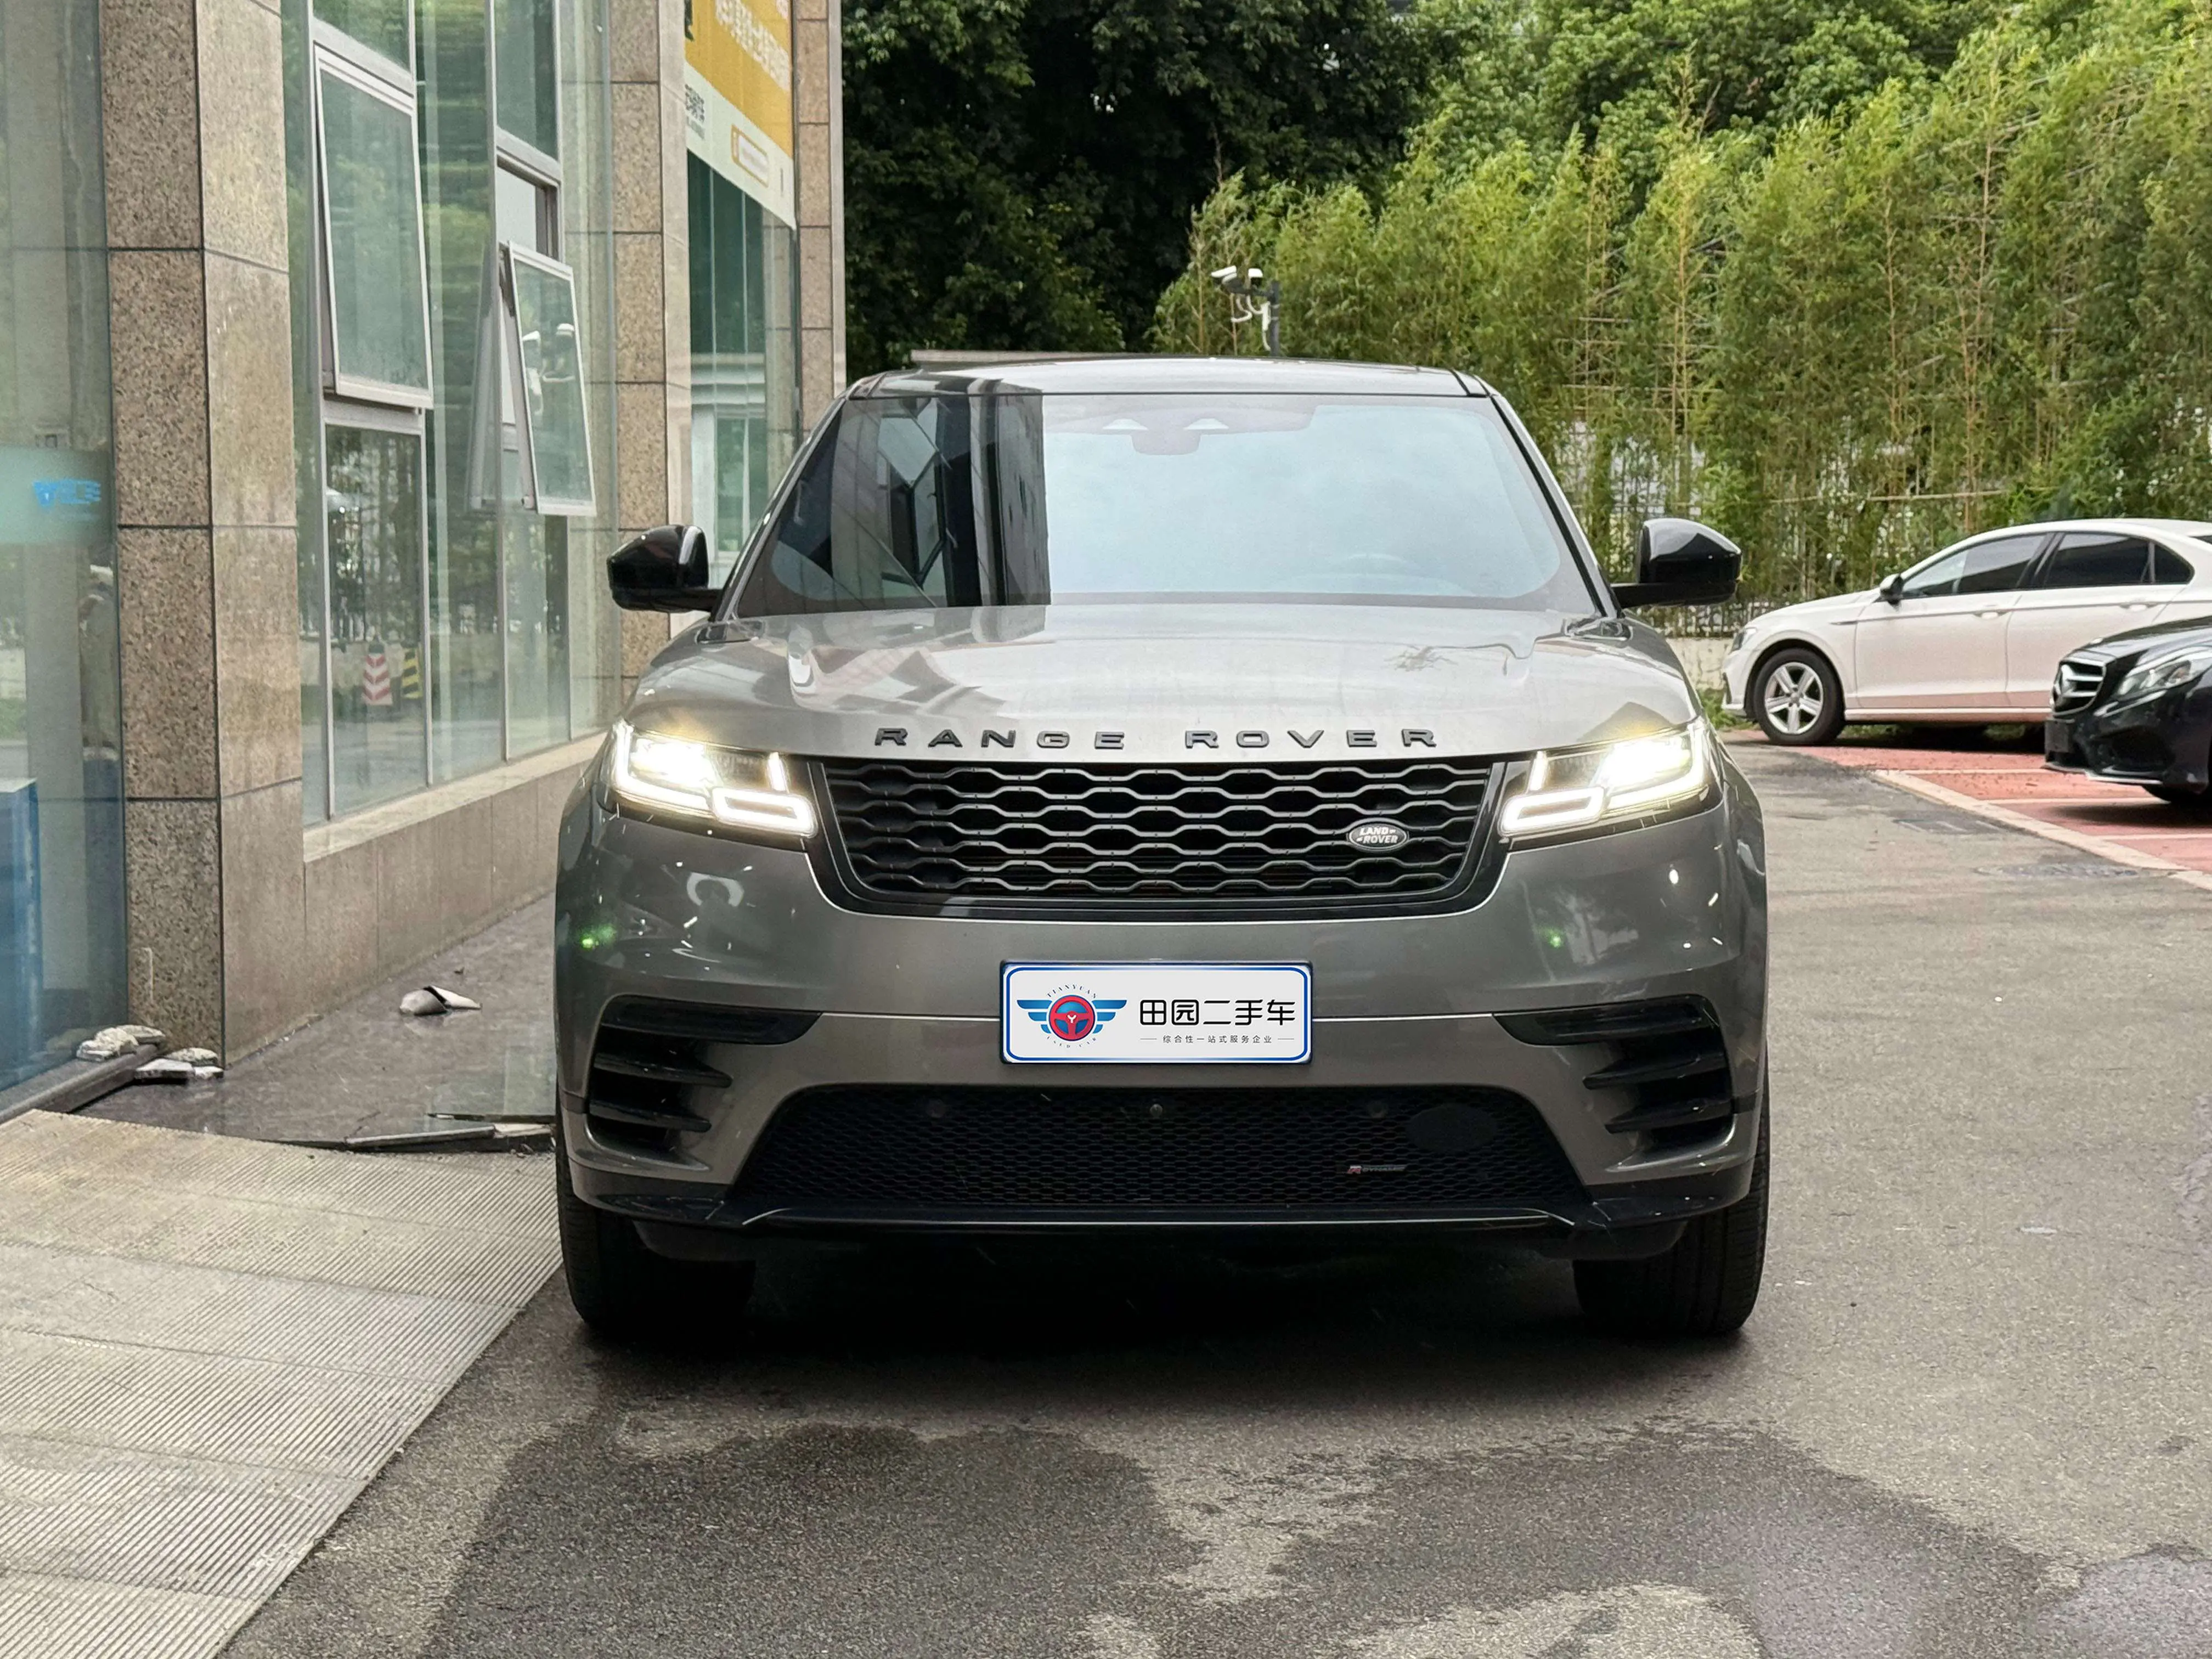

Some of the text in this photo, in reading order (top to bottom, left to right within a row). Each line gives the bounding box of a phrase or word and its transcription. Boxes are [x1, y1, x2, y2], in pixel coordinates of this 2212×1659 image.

[874, 727, 1437, 750] RANGE ROVER
[1140, 999, 1295, 1025] 田园二手车
[1163, 1035, 1272, 1043] 综合性一站式服务企业
